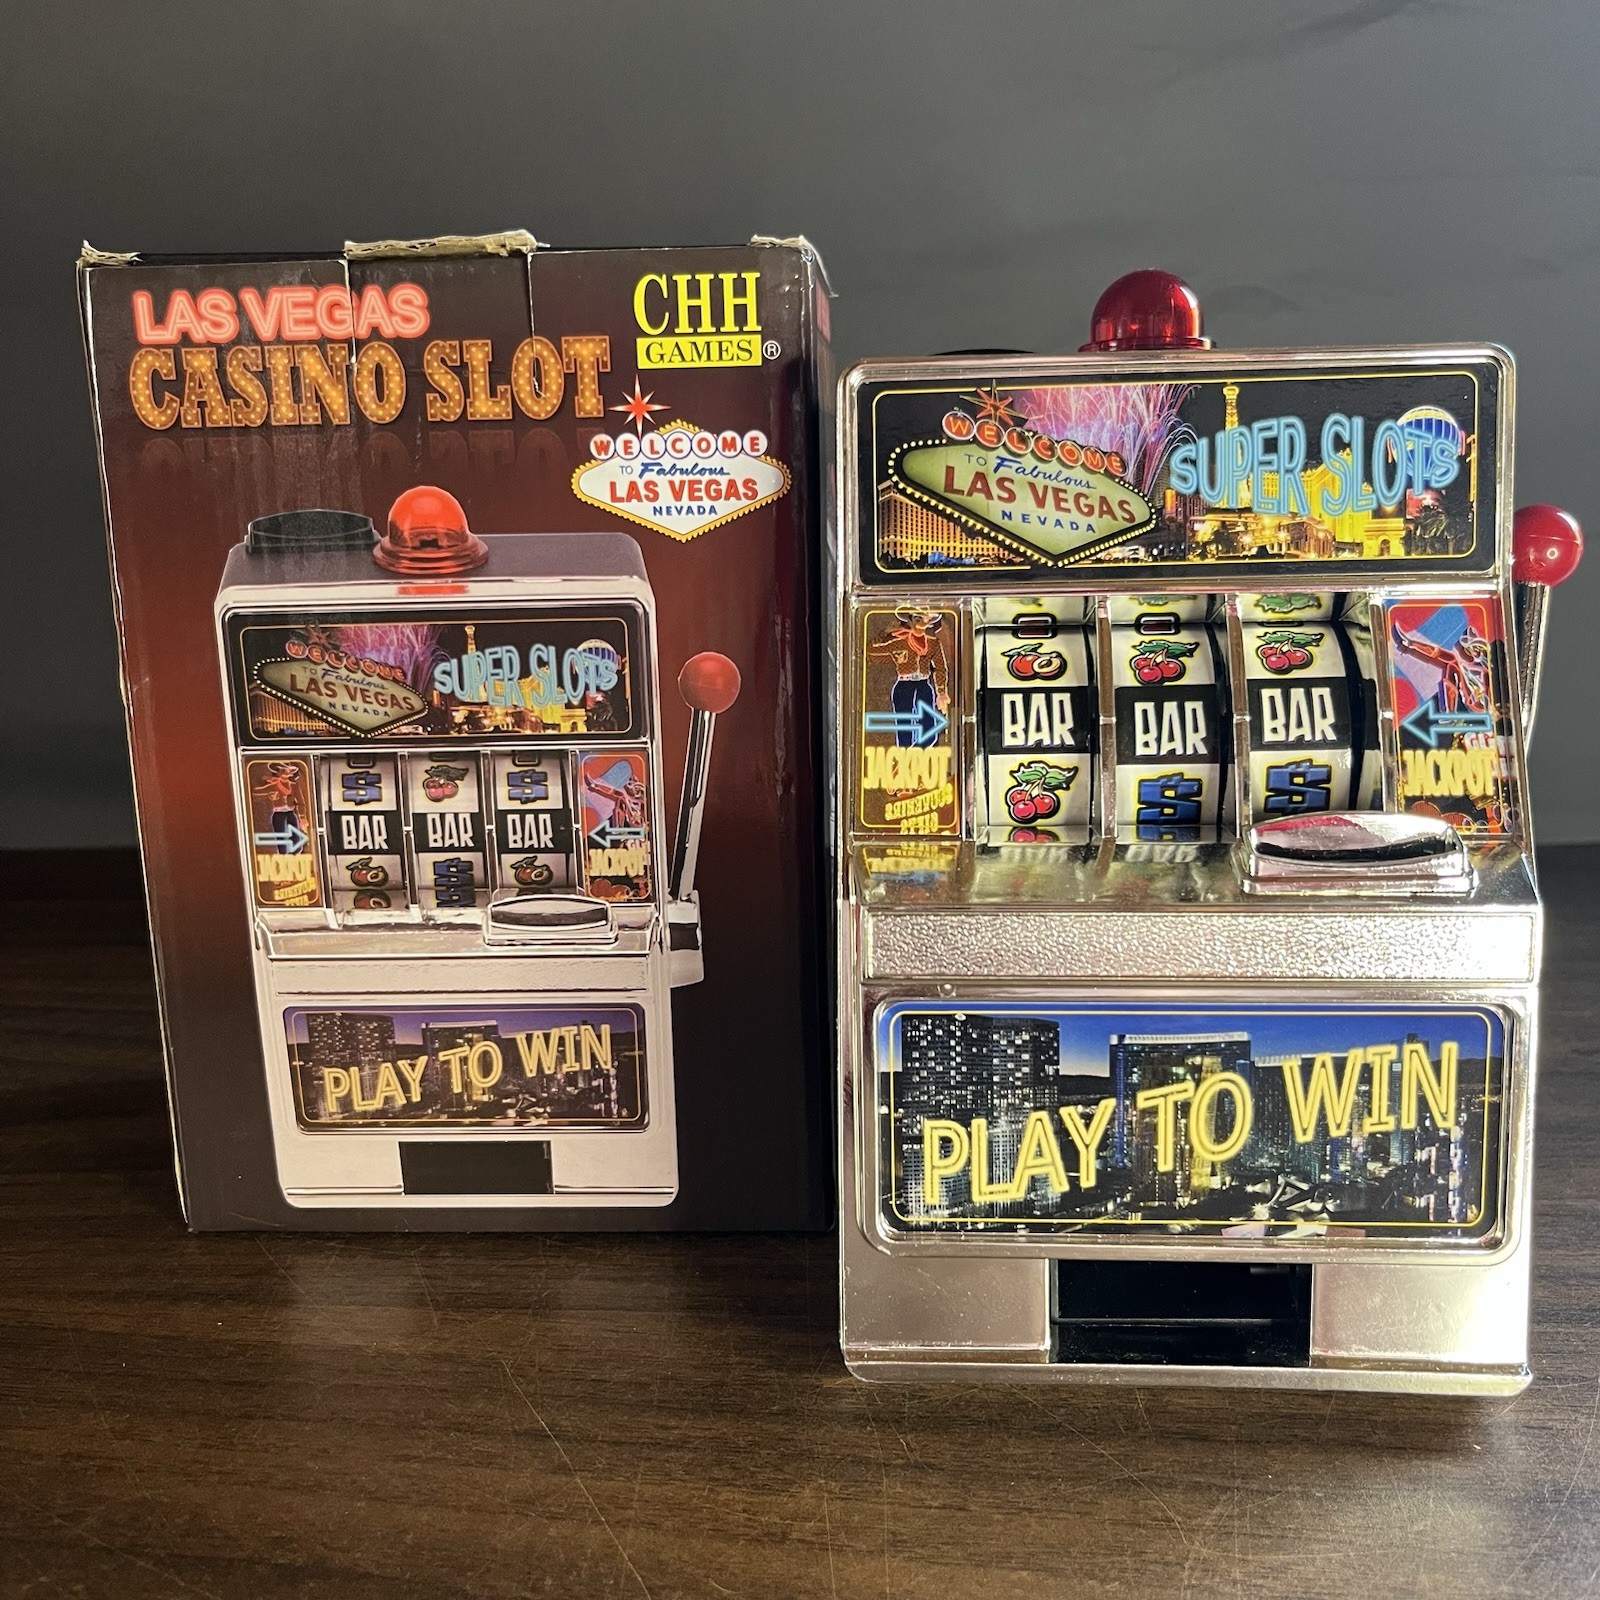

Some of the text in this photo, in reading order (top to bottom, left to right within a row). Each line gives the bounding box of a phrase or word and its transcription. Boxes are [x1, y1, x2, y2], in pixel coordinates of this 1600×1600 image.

[132, 282, 430, 344] LAS VEGAS
[633, 272, 762, 335] CHH
[645, 341, 754, 363] GAMES
[129, 335, 612, 430] CASINO SLOT
[593, 435, 761, 458] WELCOME
[949, 416, 1124, 473] WELCOME
[1169, 412, 1461, 517] SUPER SLOTS
[609, 478, 759, 504] LAS VEGAS
[619, 462, 730, 479] TO Fabulous
[964, 453, 1097, 490] TO Fabulous
[653, 505, 718, 517] NEVADA
[943, 465, 1136, 524] LAS VEGAS
[1001, 509, 1096, 534] NEVADA
[289, 674, 415, 712] LAS VEGAS
[302, 666, 389, 690] TO Fabulous
[433, 643, 619, 707] SUPER SLOTS
[328, 701, 391, 718] NEVADA
[1002, 692, 1076, 748] BAR
[1133, 701, 1207, 757] BAR
[1261, 687, 1337, 743] BAR
[862, 746, 952, 789] JACKPOT
[1402, 749, 1496, 797] JACKPOT
[340, 815, 389, 851] BAR
[426, 813, 474, 850] BAR
[507, 814, 554, 850] BAR
[323, 1023, 613, 1114] PLAY TO WIN
[922, 1040, 1460, 1204] PLAY TO WIN
